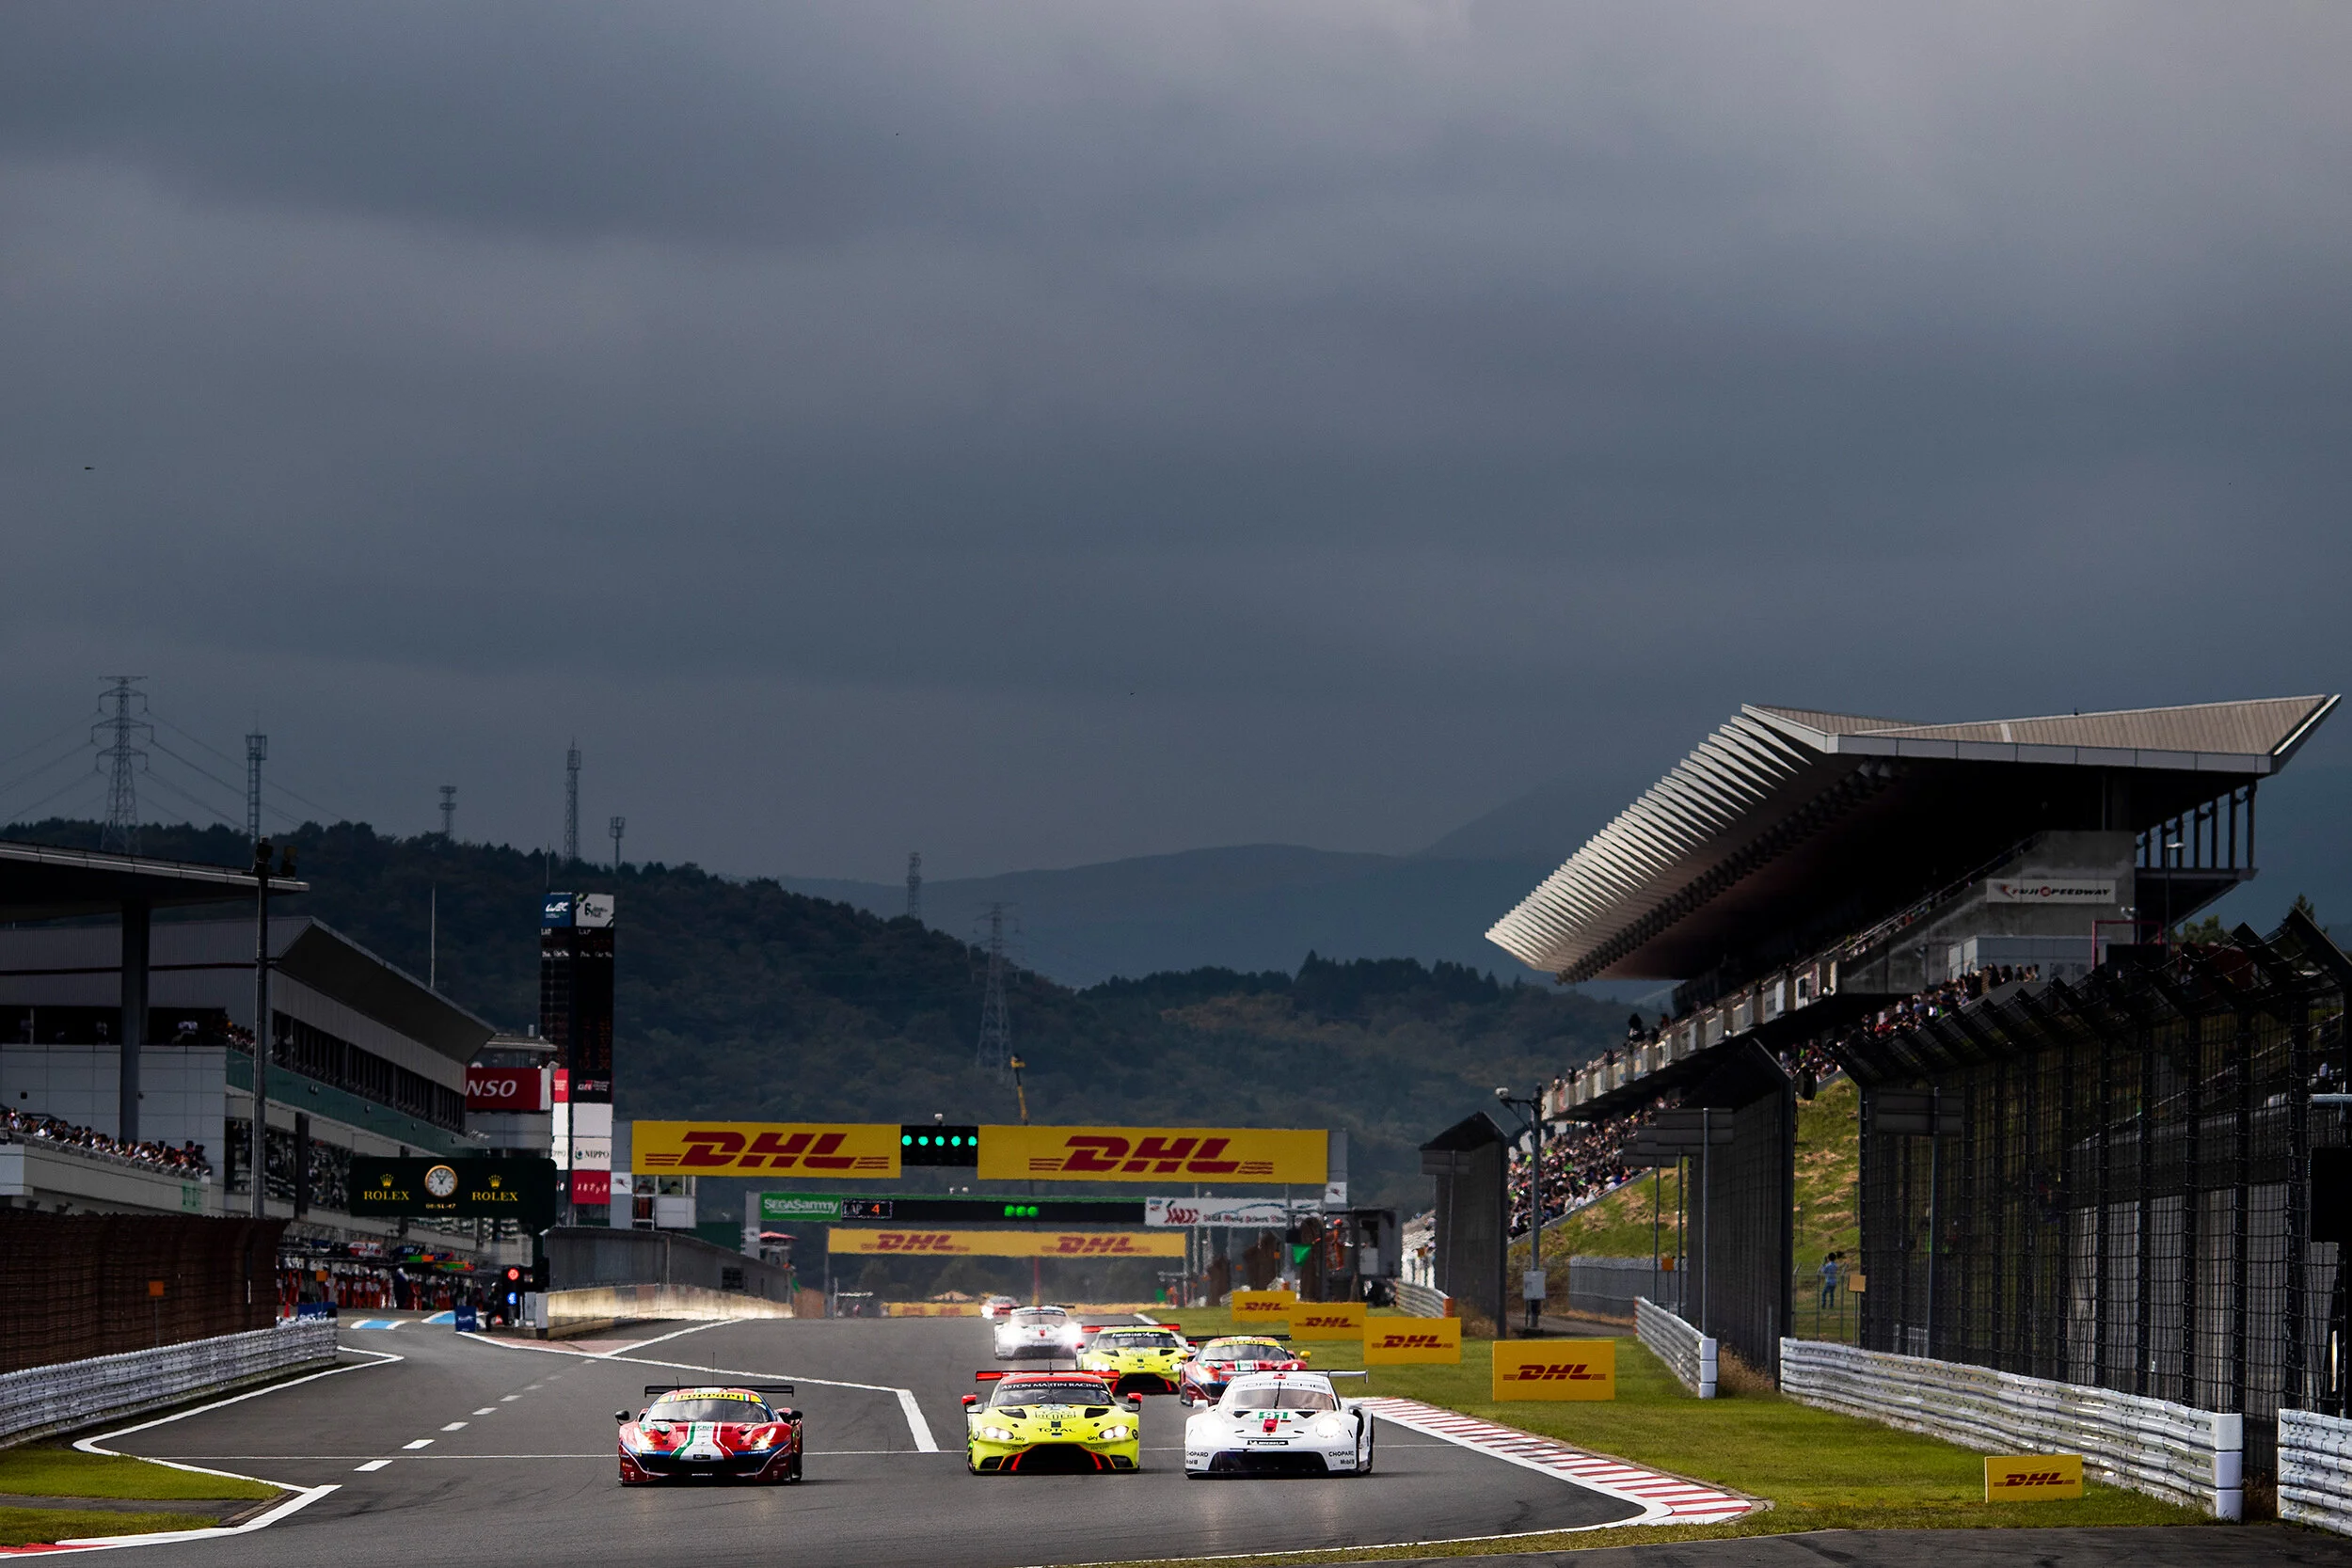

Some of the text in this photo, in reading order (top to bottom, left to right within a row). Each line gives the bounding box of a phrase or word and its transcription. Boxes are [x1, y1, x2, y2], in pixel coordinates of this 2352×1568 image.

[584, 1149, 611, 1160] NIPPO
[677, 1132, 857, 1169] DHL
[1061, 1135, 1240, 1174] DHL
[363, 1191, 410, 1201] ROLEX
[471, 1191, 518, 1202] ROLEX
[844, 1204, 880, 1214] LAP 4
[876, 1234, 955, 1251] DHL
[1056, 1236, 1136, 1254] DHL
[1244, 1301, 1283, 1311] DHL
[1305, 1316, 1353, 1328] DHL
[1383, 1335, 1442, 1349] DHL
[1518, 1364, 1593, 1381] DHL
[2005, 1472, 2064, 1487] DHL
